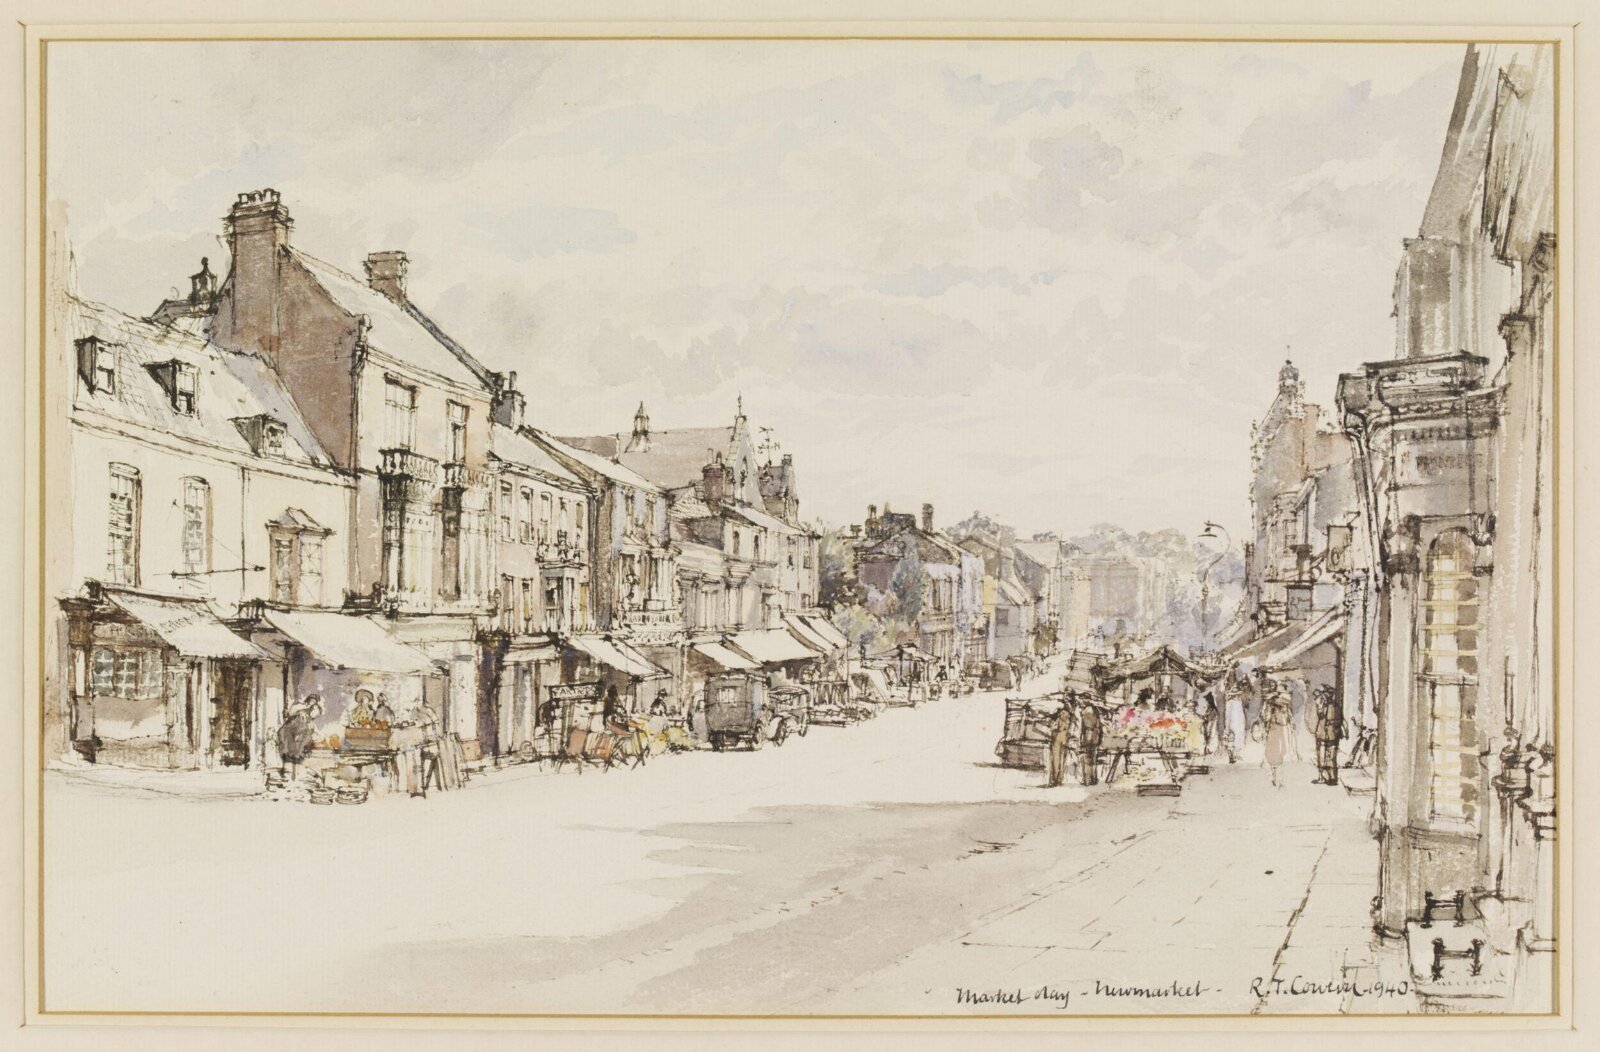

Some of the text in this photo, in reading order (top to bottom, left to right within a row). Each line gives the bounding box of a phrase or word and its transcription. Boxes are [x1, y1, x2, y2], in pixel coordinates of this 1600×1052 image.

[956, 987, 1031, 1005] Market
[1034, 985, 1070, 1009] day
[1095, 980, 1210, 998] Newmarket
